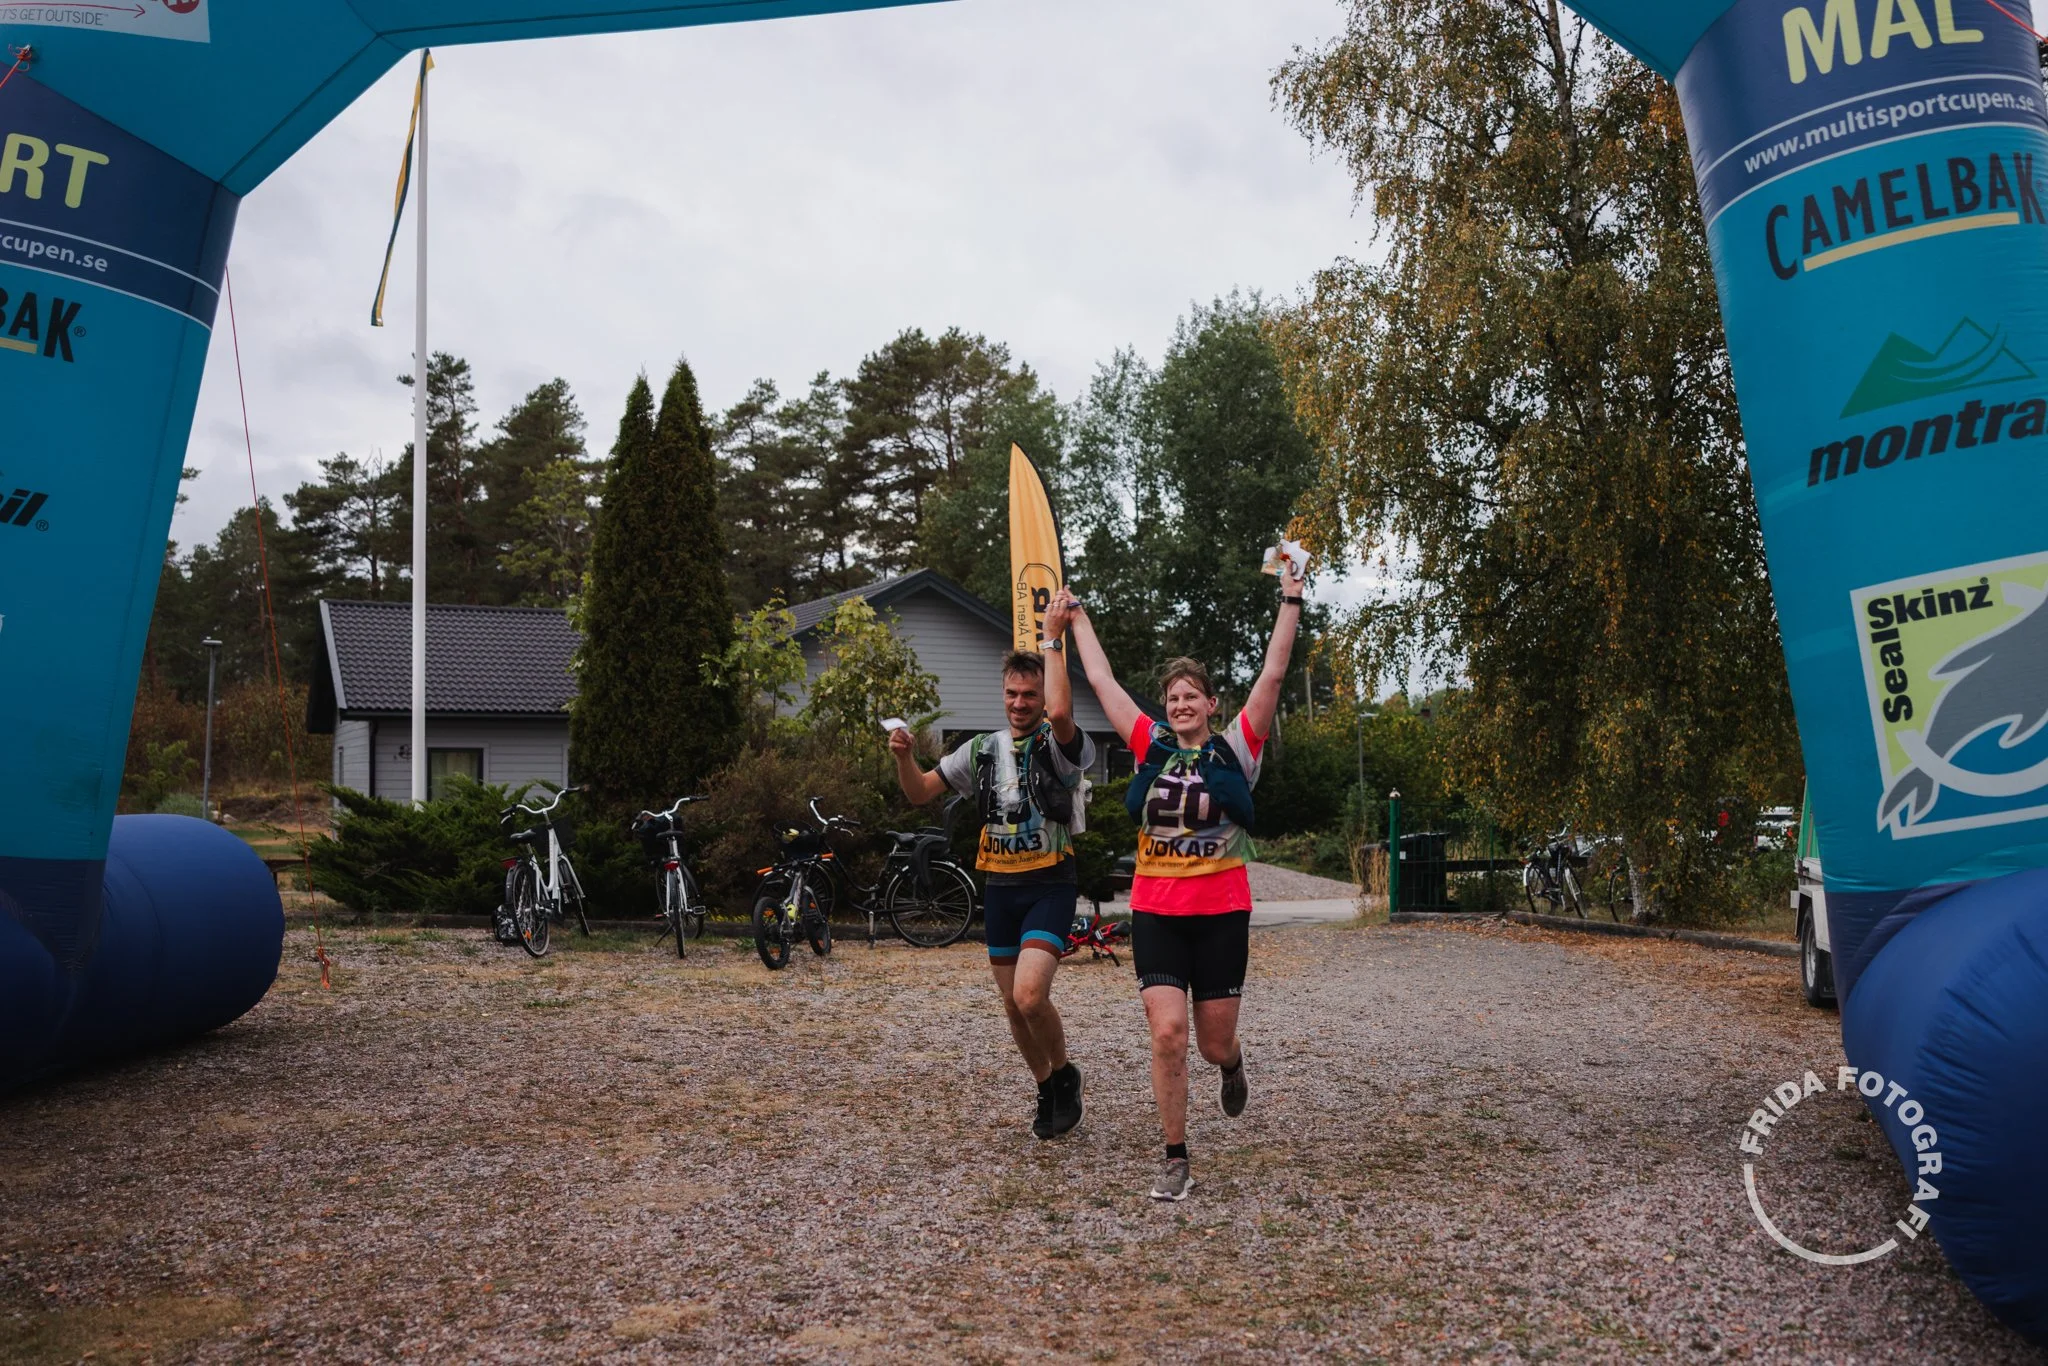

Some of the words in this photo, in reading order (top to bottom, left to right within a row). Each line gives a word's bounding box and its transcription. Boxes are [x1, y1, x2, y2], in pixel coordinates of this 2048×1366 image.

[20, 8, 44, 22] GET
[45, 9, 105, 26] OUTSIDE
[1744, 91, 2034, 173] www.multisportcupen.se
[0, 132, 110, 209] RT
[1766, 152, 2047, 281] CAMELBAK
[0, 234, 108, 272] cupen.se
[1807, 397, 2048, 487] montra
[0, 488, 49, 528] il
[1147, 777, 1221, 830] 20
[1145, 839, 1219, 858] JOKAB
